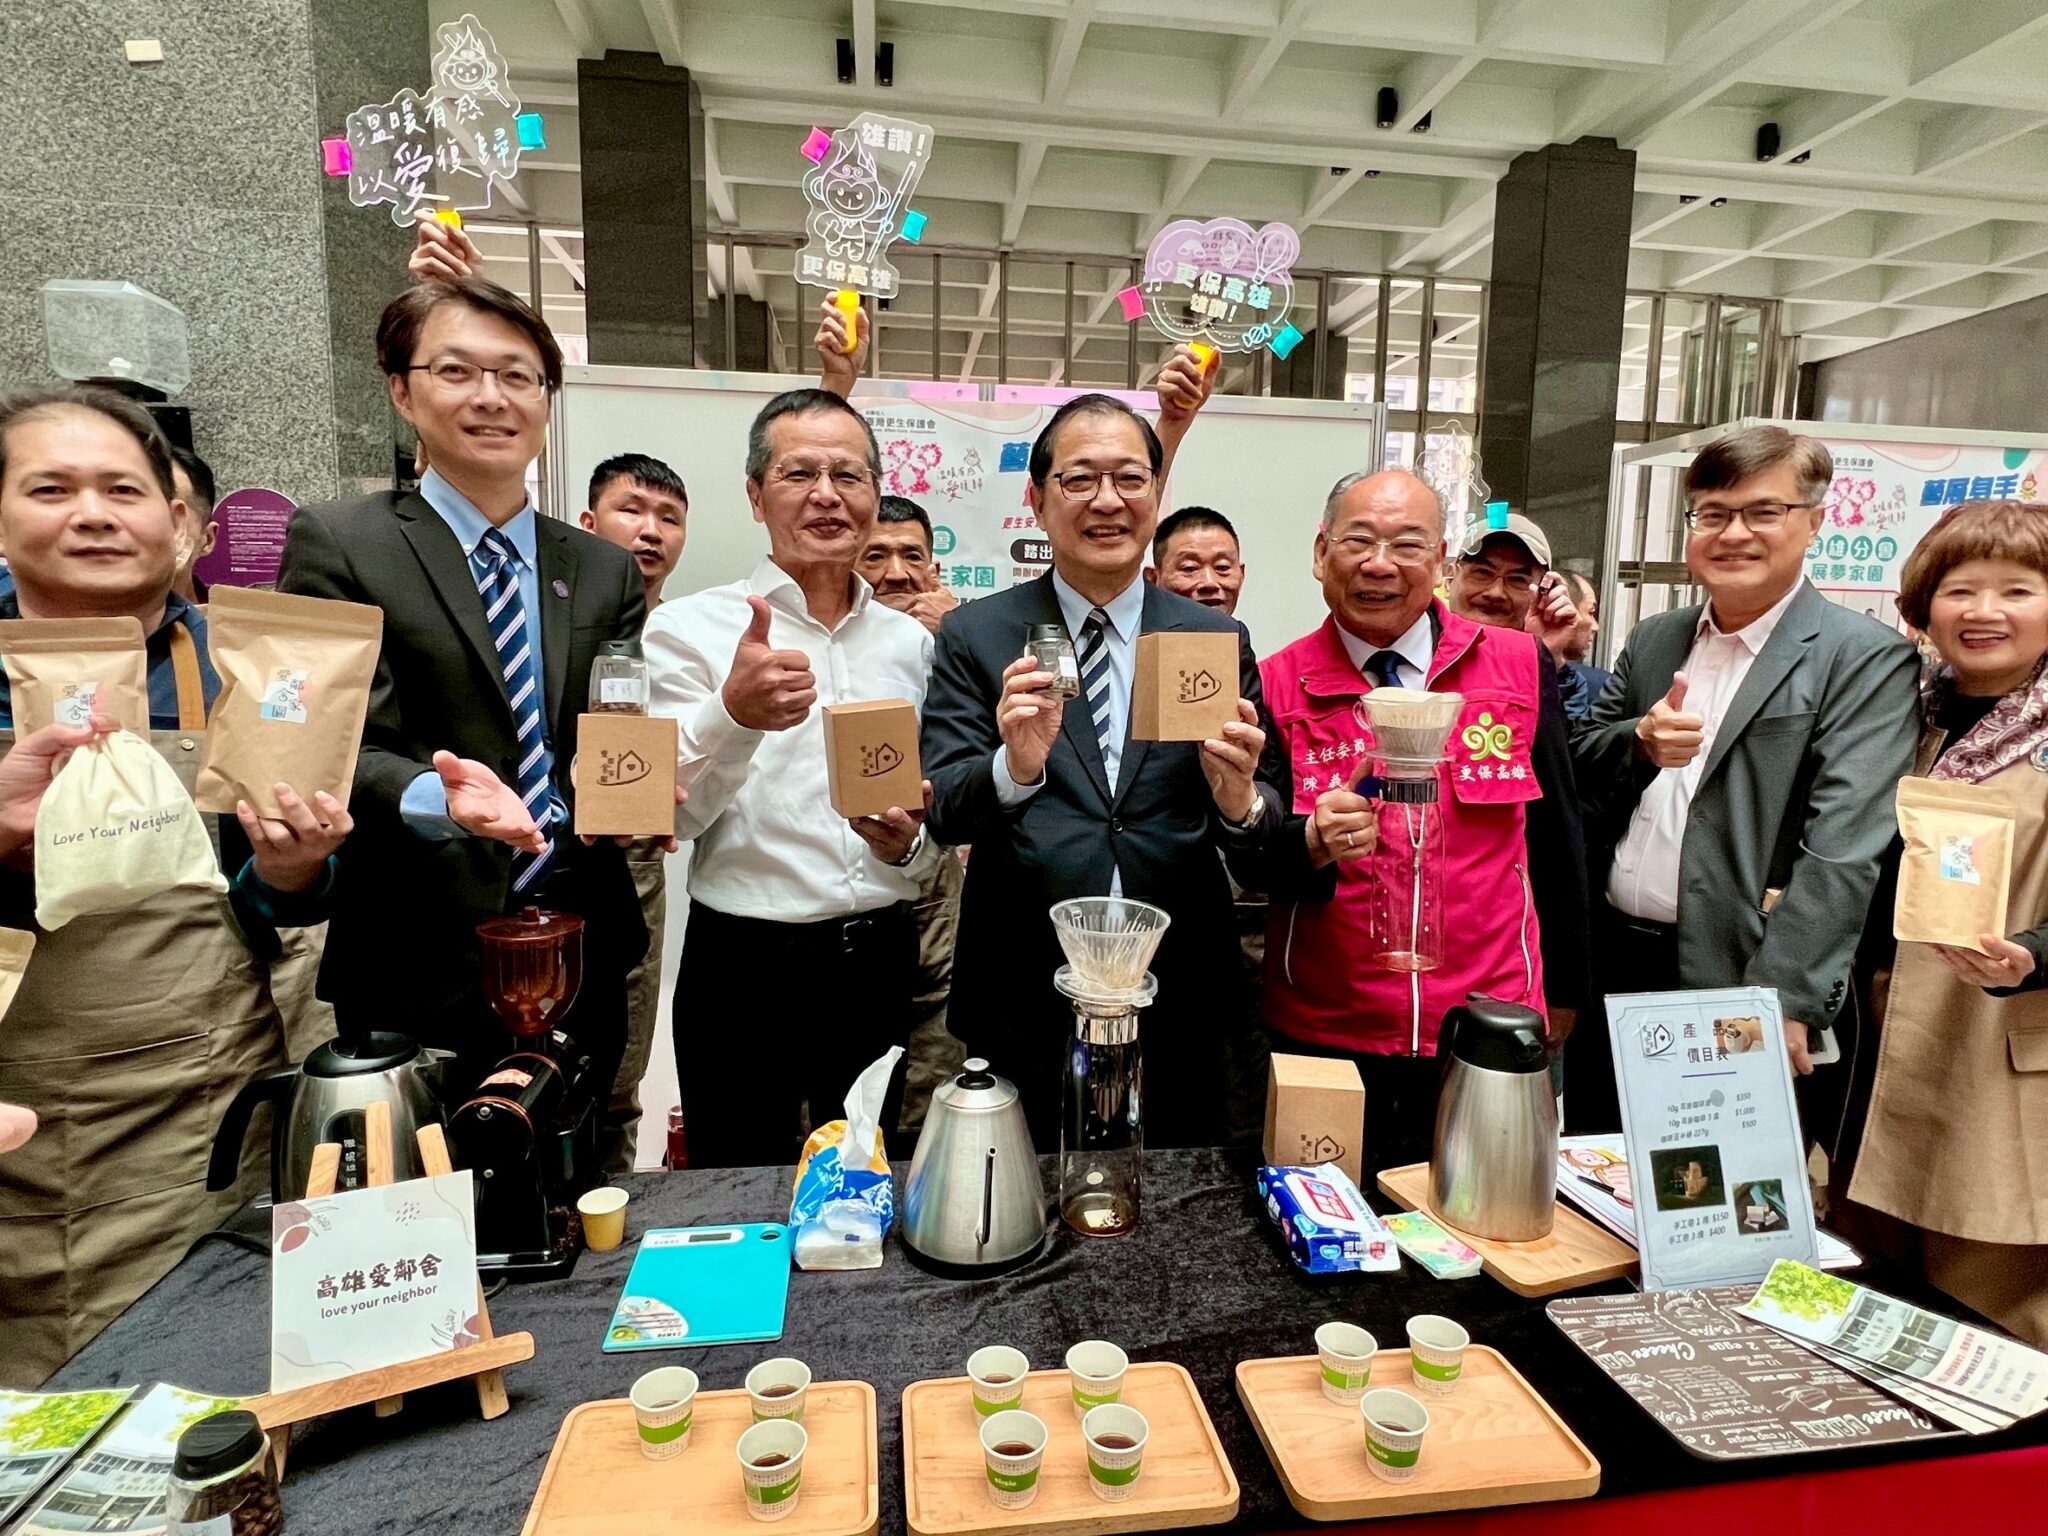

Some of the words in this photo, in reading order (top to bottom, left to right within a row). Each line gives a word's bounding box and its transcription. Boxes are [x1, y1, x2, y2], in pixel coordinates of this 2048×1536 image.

[355, 91, 485, 147] 溫暖有感
[862, 121, 927, 158] 雄讚!
[802, 254, 893, 290] 更保高雄
[1173, 262, 1273, 311] 更保高雄
[1811, 563, 1884, 583] 展夢家園
[1302, 738, 1366, 765] 主任委員
[1458, 762, 1528, 782] 更保高雄
[53, 832, 85, 846] Love
[90, 826, 125, 839] Your
[129, 810, 181, 833] Neighbor
[316, 1252, 443, 1300] 高雄愛鄰舍
[320, 1305, 348, 1319] love
[350, 1297, 380, 1315] your
[382, 1285, 438, 1305] neighbor
[1631, 1341, 1696, 1361] Cheese
